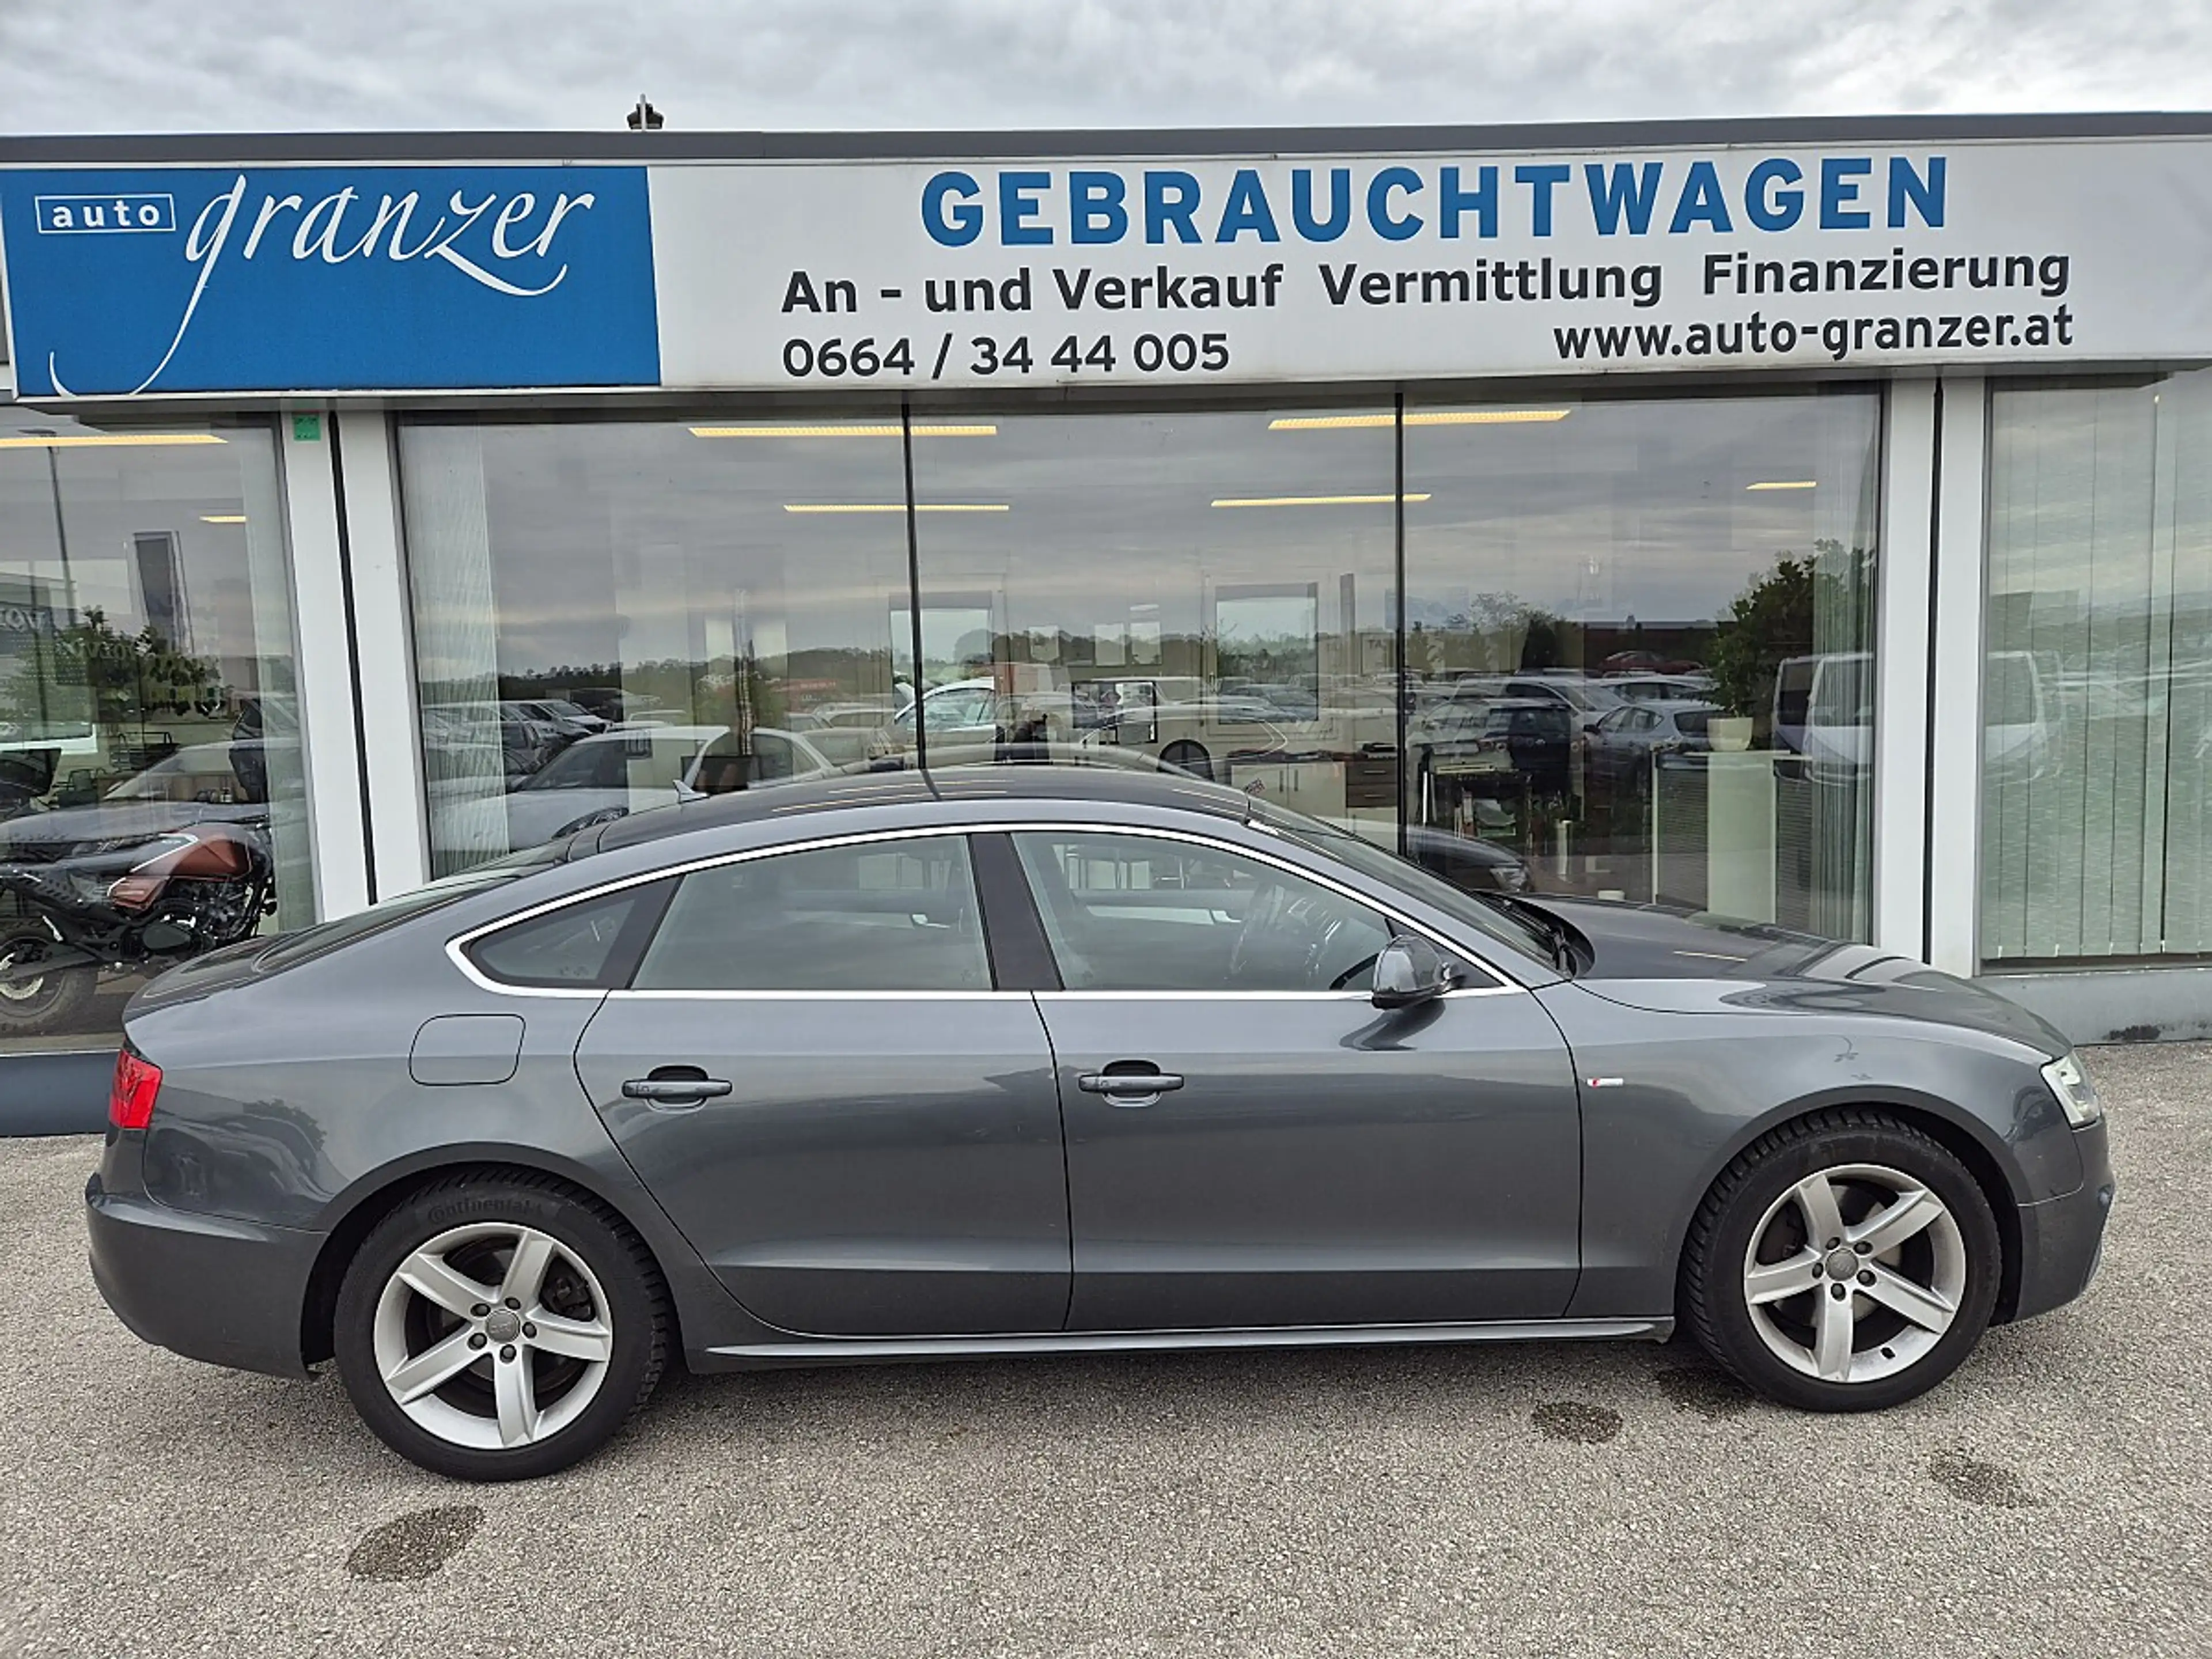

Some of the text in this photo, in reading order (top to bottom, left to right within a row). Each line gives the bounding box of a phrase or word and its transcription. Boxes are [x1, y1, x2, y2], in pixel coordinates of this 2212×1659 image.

[52, 200, 160, 228] auto
[922, 157, 1946, 247] GEBRAUCHTWAGEN
[49, 174, 596, 396] granzer
[781, 271, 857, 313] An
[925, 267, 1032, 312] und
[1052, 263, 1285, 310] Verkauf
[1318, 257, 1662, 308] Vermittlung
[1704, 247, 2070, 297] Finanzierung
[783, 333, 1229, 380] 0664 / 34 44 005
[1553, 305, 2073, 362] www.auto-granzer.at
